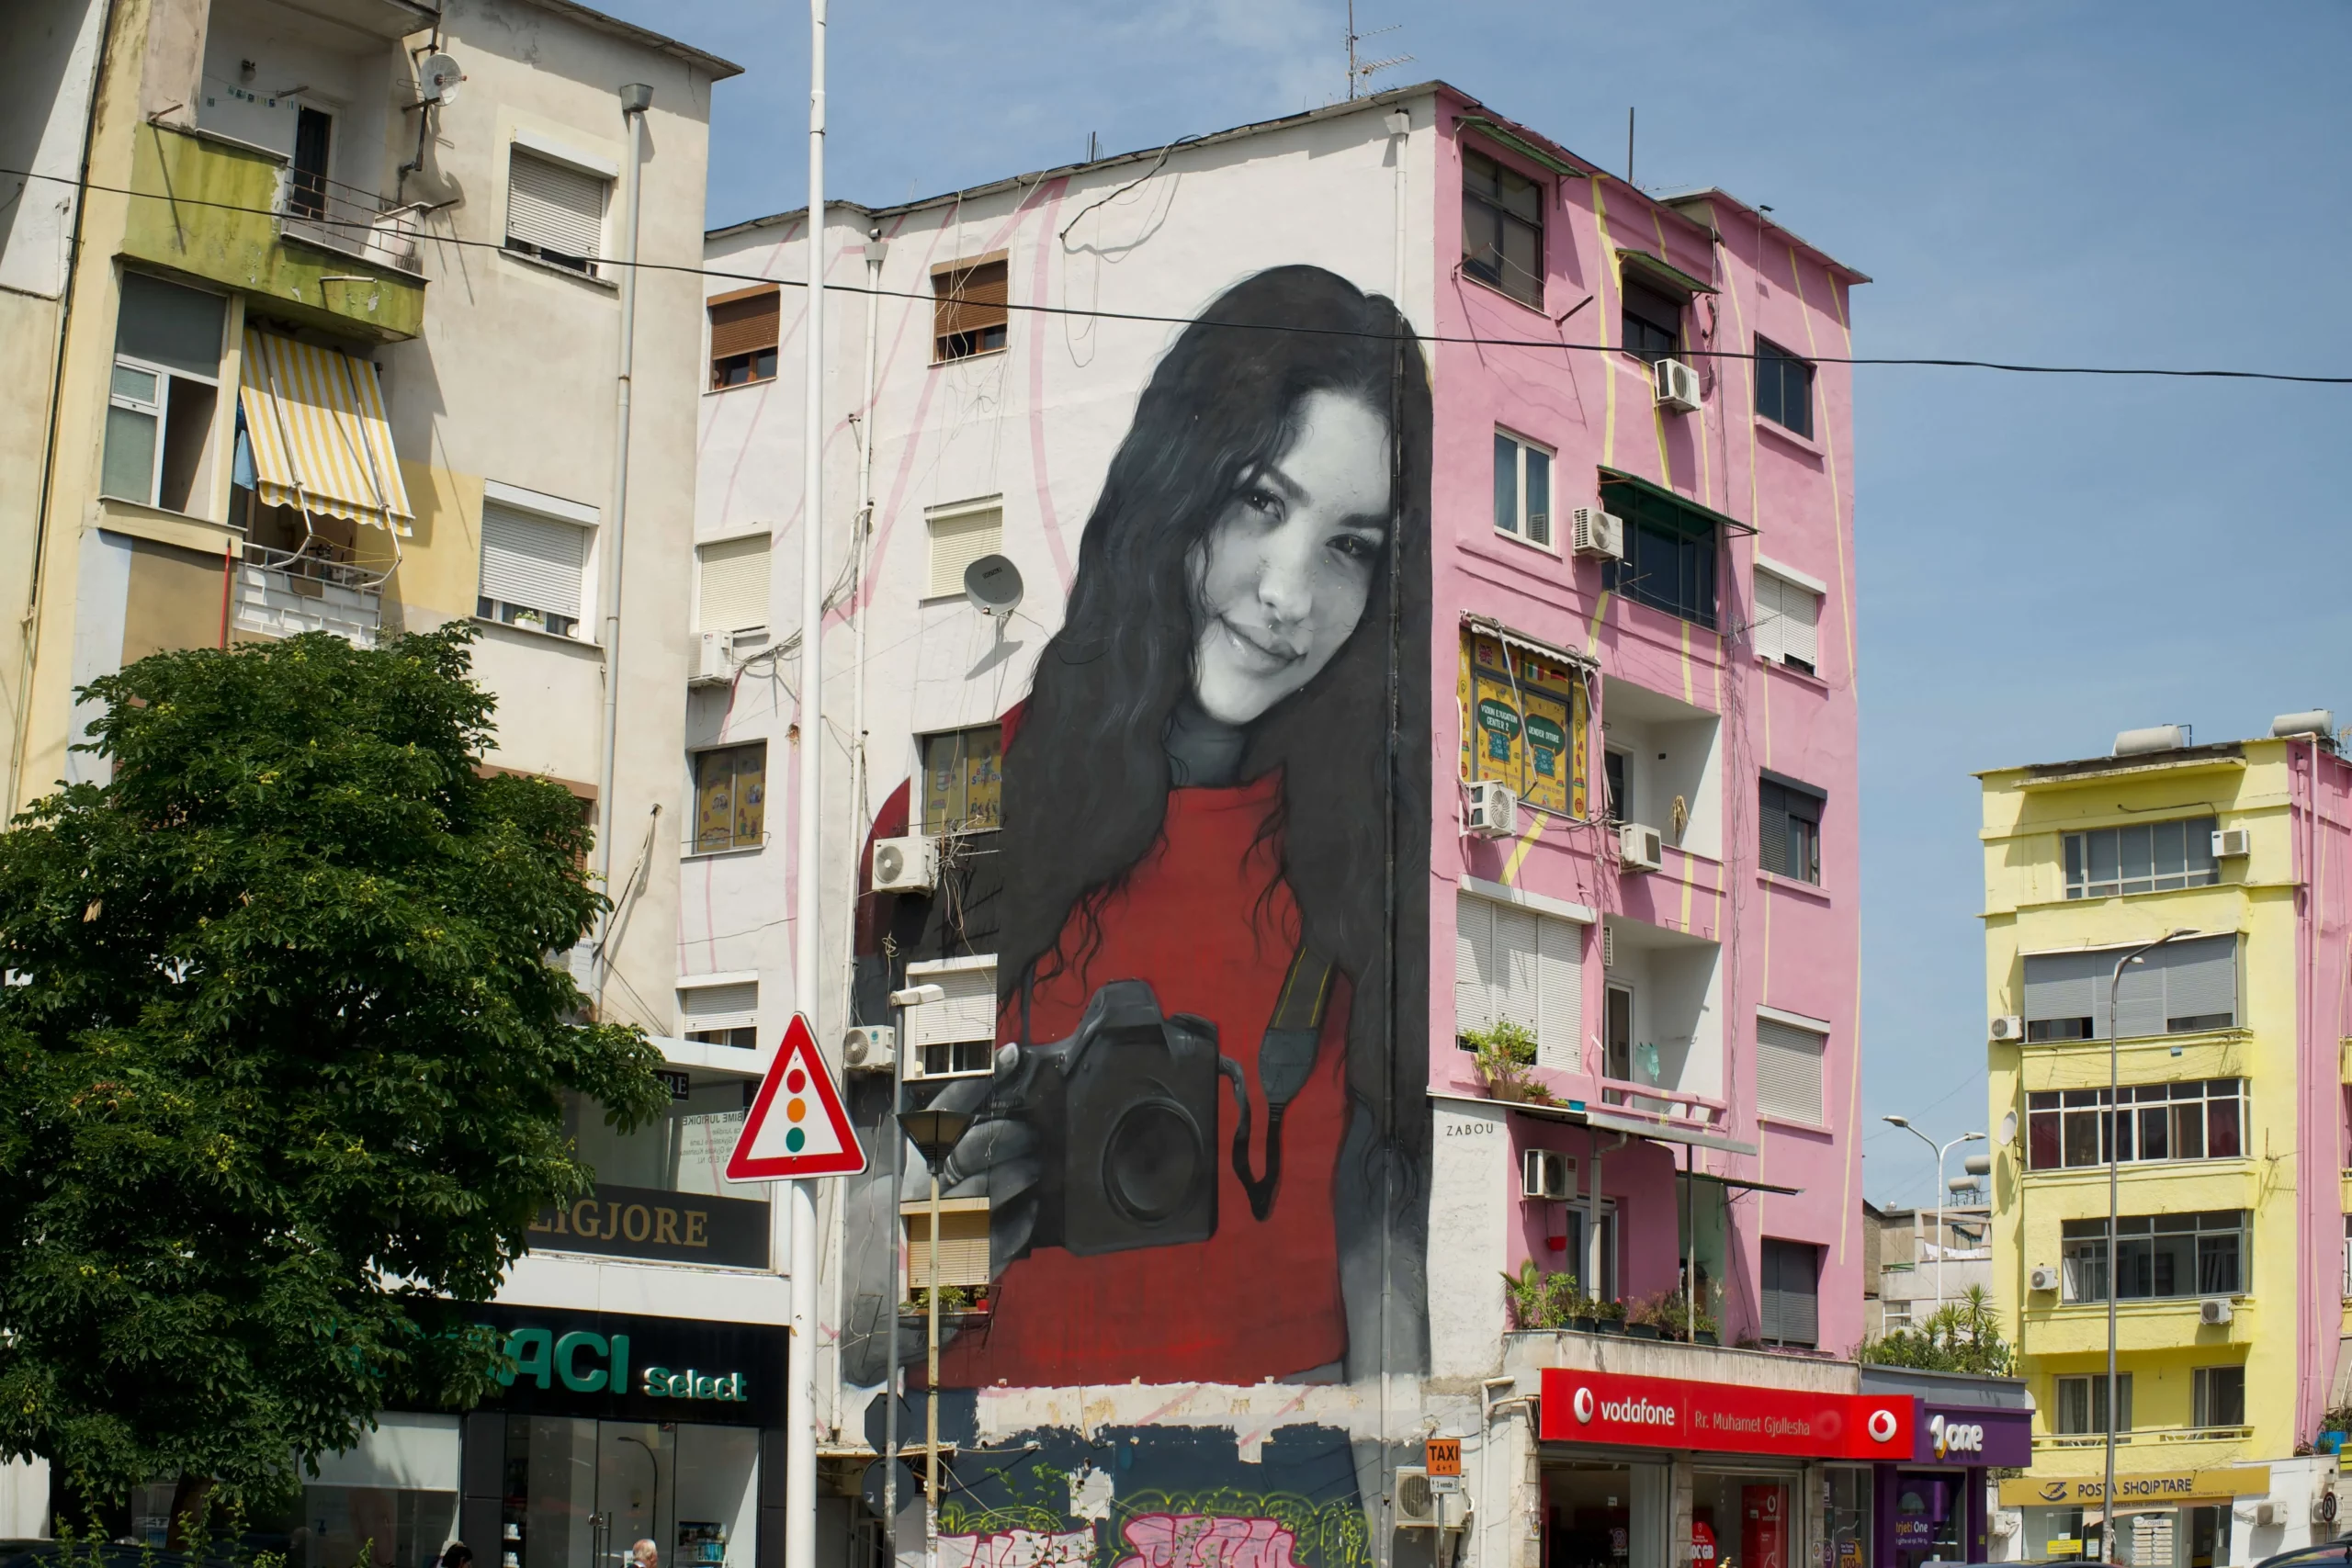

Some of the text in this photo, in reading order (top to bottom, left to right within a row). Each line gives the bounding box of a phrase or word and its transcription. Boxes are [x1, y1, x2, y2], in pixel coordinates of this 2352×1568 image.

[1446, 1122, 1494, 1136] ZABOU
[641, 1367, 747, 1402] Select
[1600, 1396, 1810, 1438] vodafone Rr. Muhamet Gjollesha
[1429, 1445, 1459, 1461] TAXI
[2123, 1478, 2192, 1495] SHQIPTARE
[1914, 1521, 1928, 1533] One
